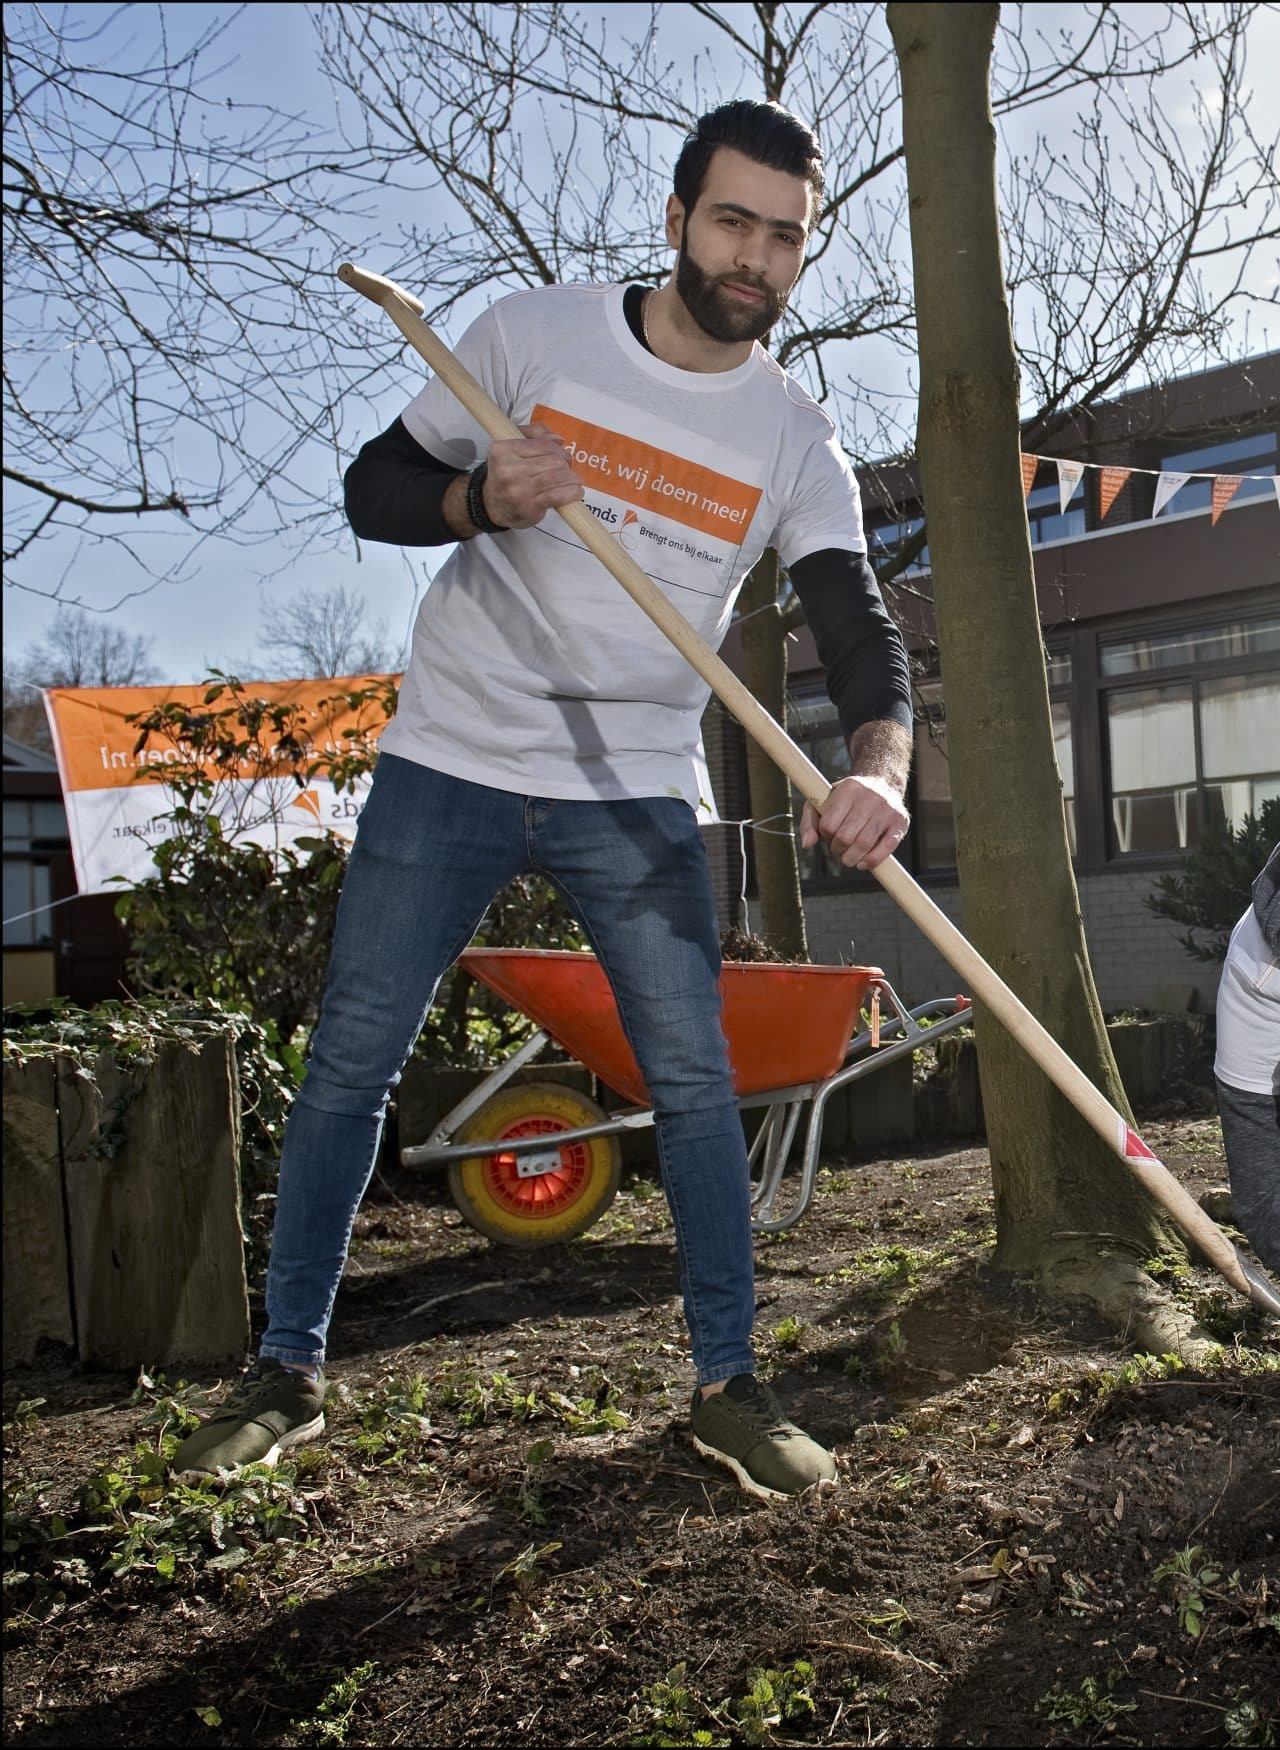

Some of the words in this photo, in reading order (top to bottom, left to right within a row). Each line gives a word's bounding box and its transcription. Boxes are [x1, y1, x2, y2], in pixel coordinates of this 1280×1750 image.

[617, 463, 649, 491] wij
[651, 474, 698, 506] doen
[701, 497, 748, 525] mee!
[639, 526, 668, 546] Brengt
[668, 540, 684, 551] ons
[684, 543, 696, 558] bij
[696, 550, 724, 566] elkaar.
